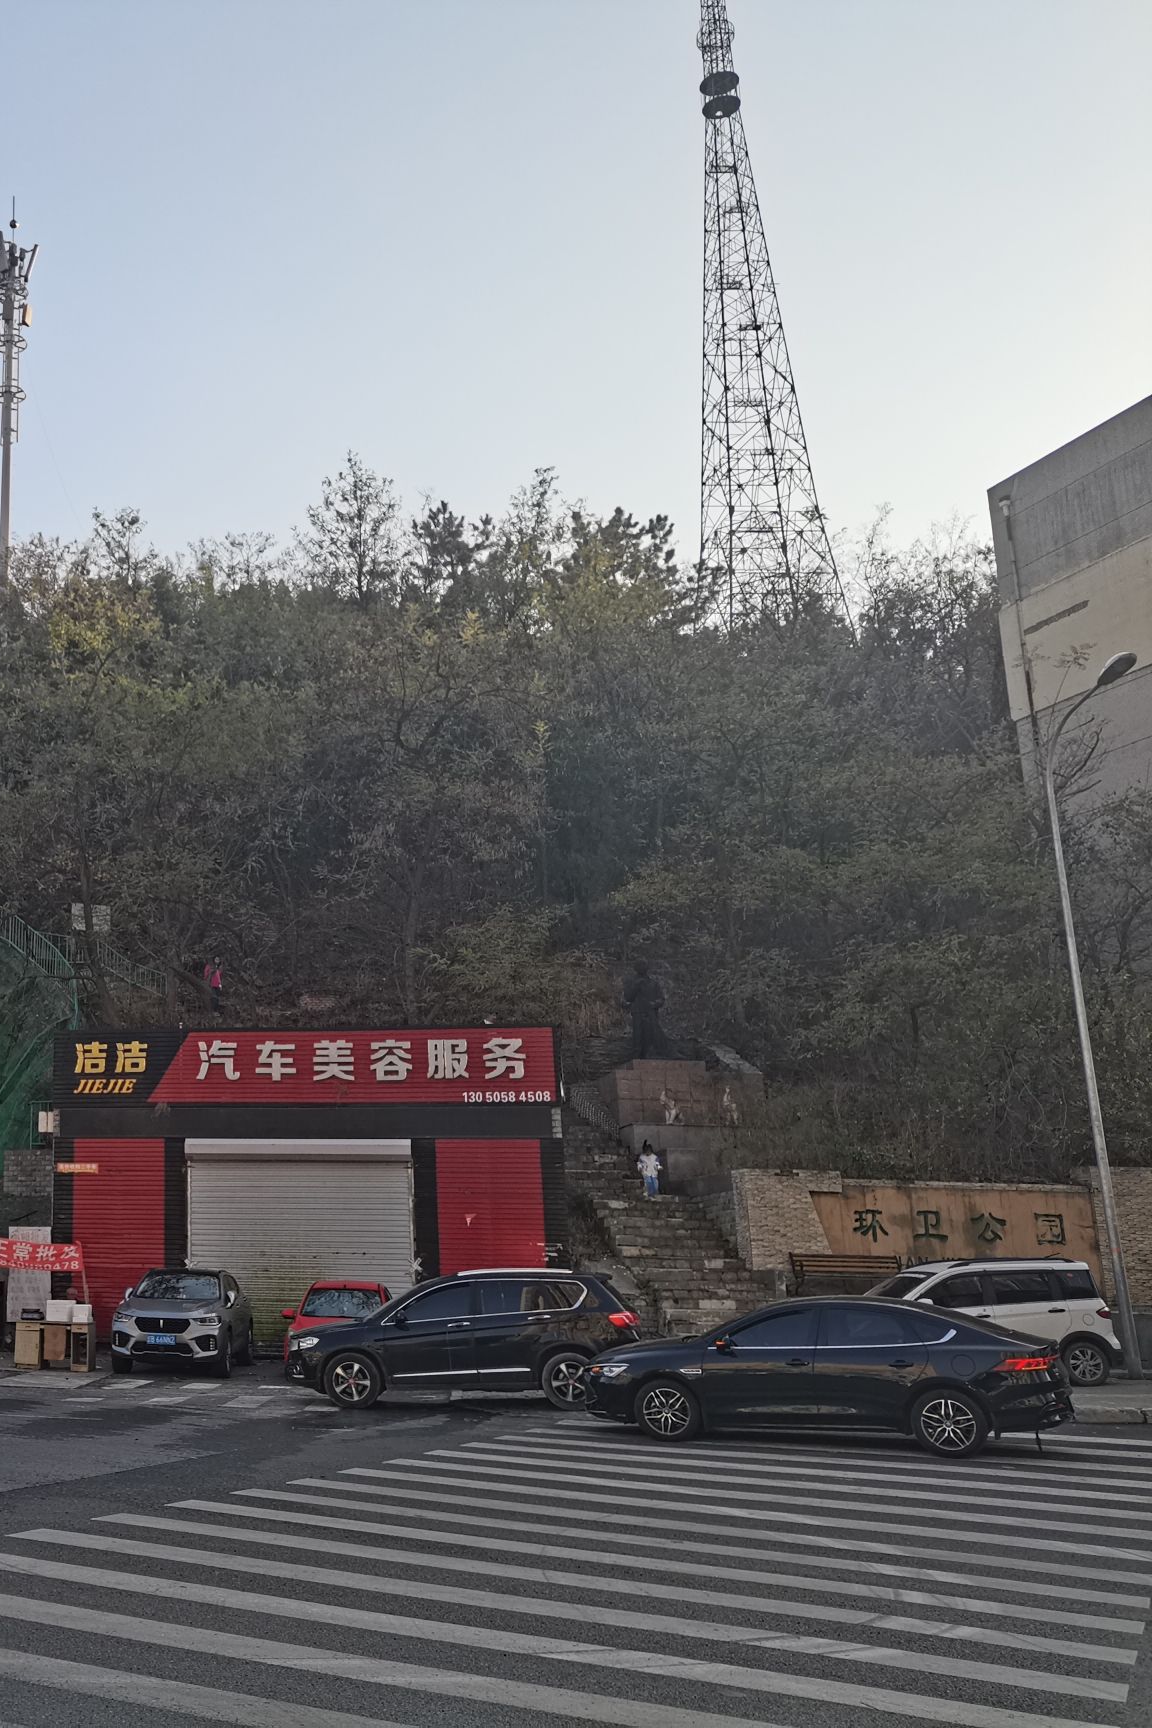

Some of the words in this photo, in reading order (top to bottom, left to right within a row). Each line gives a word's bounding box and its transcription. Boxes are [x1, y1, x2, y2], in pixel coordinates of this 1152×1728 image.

[74, 1040, 148, 1074] 洁洁
[195, 1037, 527, 1082] 汽车美容服务
[73, 1079, 137, 1094] JIEJIE
[462, 1091, 483, 1103] 130
[485, 1091, 516, 1102] 5058
[519, 1090, 551, 1102] 4508
[852, 1207, 1067, 1246] 环卫公园
